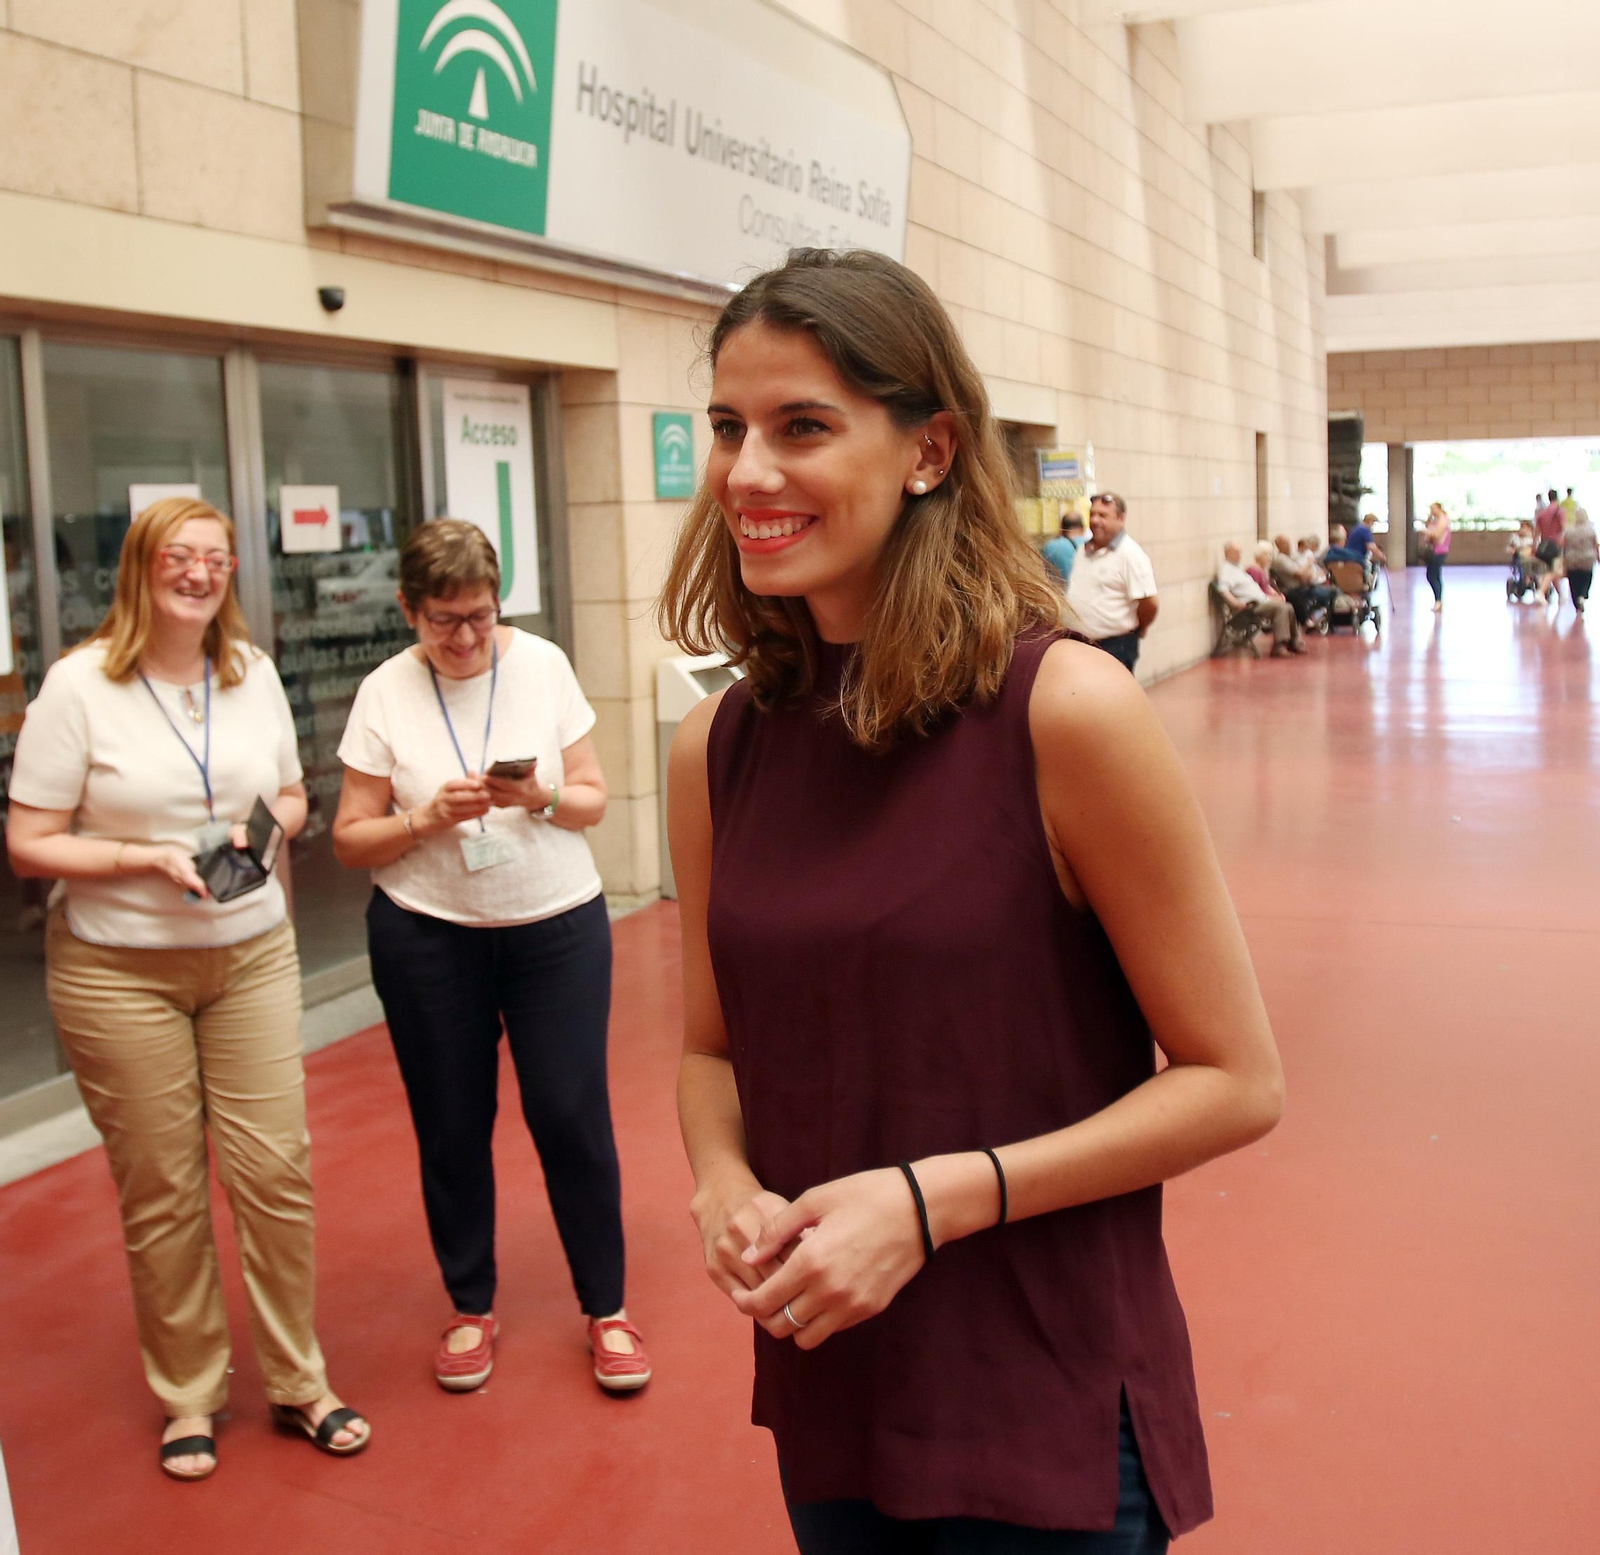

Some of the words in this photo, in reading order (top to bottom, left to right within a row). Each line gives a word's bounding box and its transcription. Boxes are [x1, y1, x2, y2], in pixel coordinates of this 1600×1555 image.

[414, 108, 456, 144] JUNTA
[458, 121, 476, 151] DE
[577, 60, 677, 147] Hospital
[685, 105, 804, 193] Universitario
[807, 158, 853, 213] Reina
[460, 414, 518, 446] Acceso
